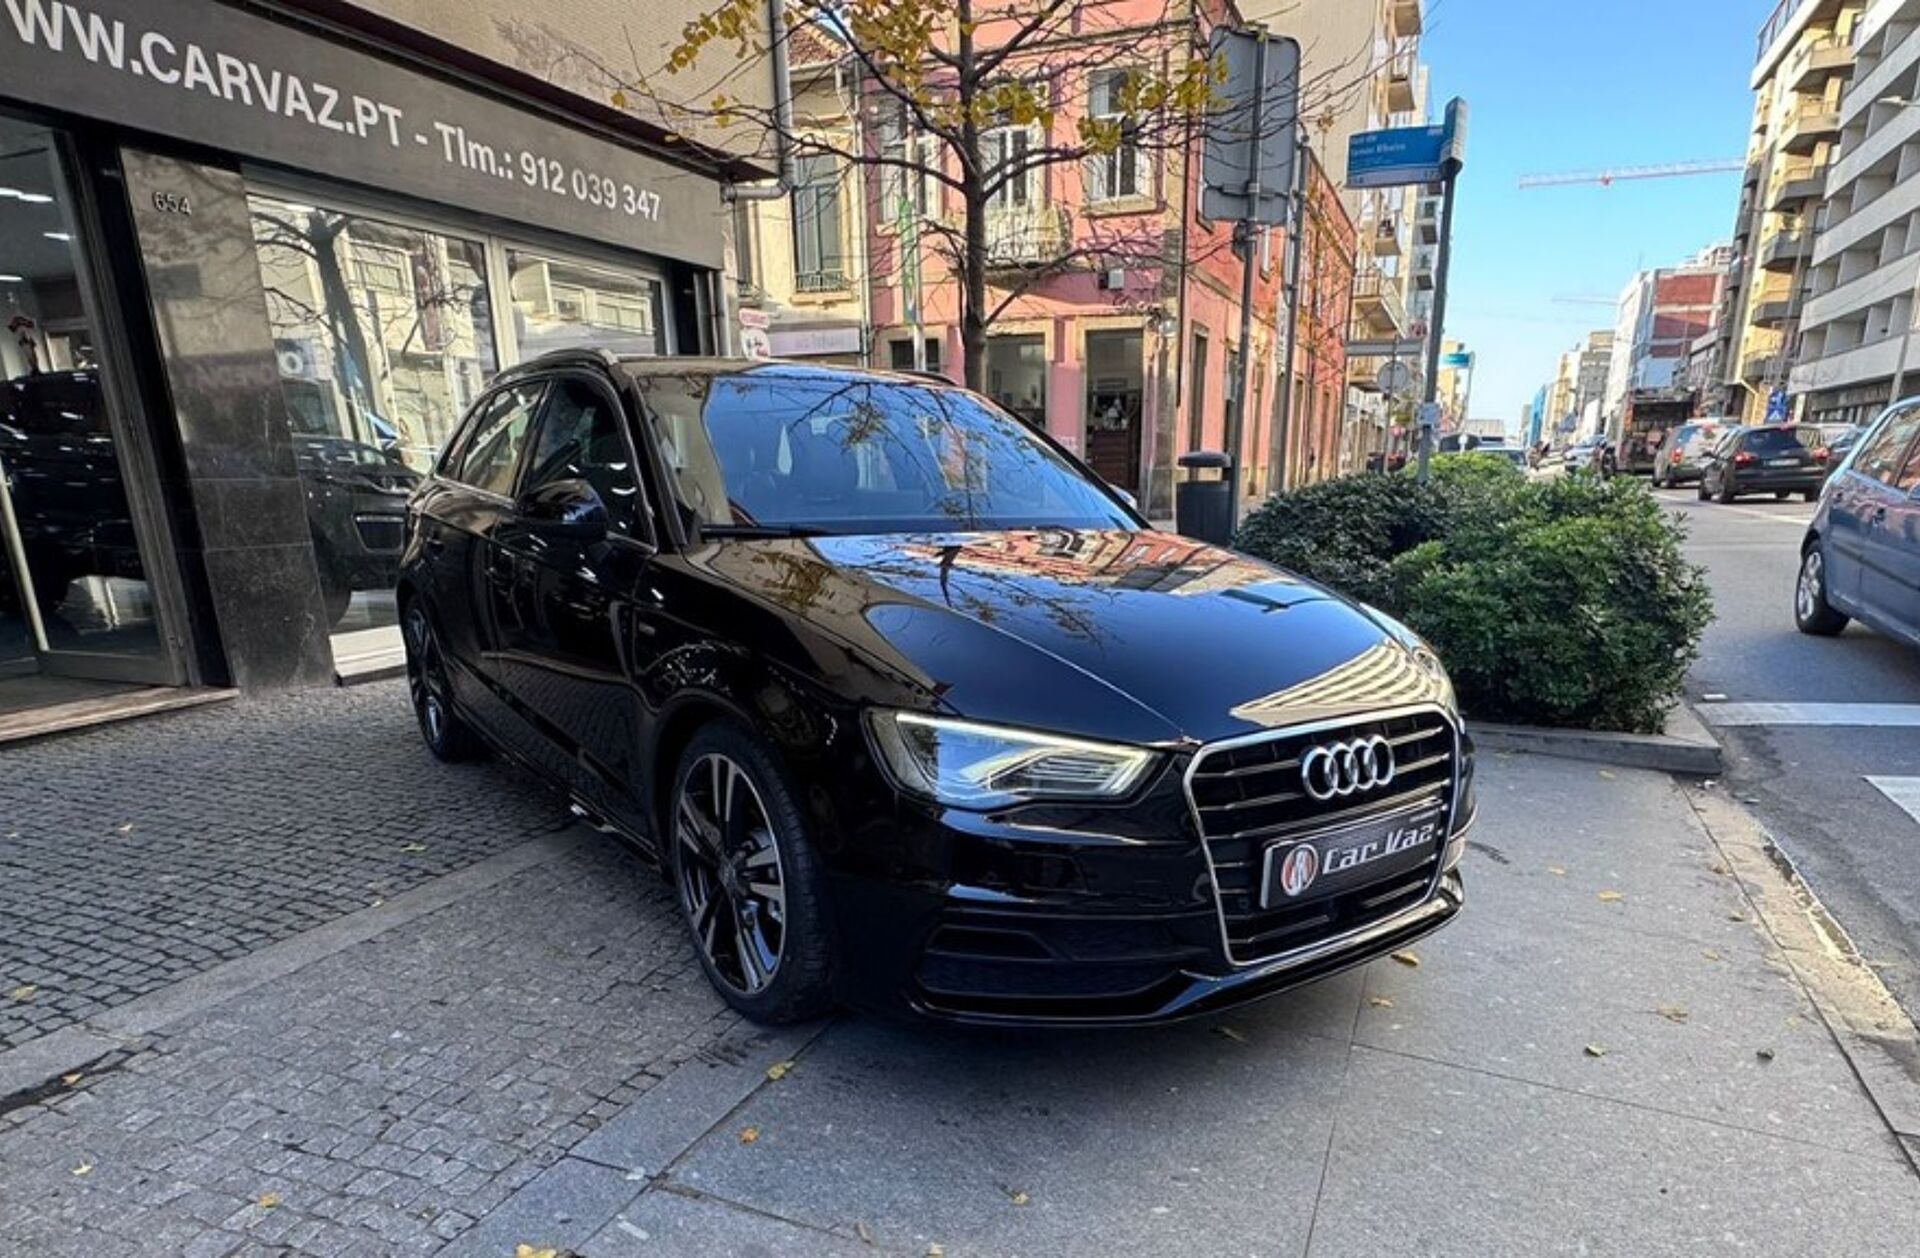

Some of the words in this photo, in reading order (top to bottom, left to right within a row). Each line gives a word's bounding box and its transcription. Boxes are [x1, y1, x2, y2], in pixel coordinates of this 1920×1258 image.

[414, 132, 429, 146] -
[433, 120, 514, 181] Tlm.:
[520, 151, 567, 196] 912
[571, 168, 617, 209] 039
[622, 184, 661, 222] 347
[151, 191, 192, 216] 654
[1322, 841, 1379, 875] Car
[1384, 822, 1436, 855] Vaz
